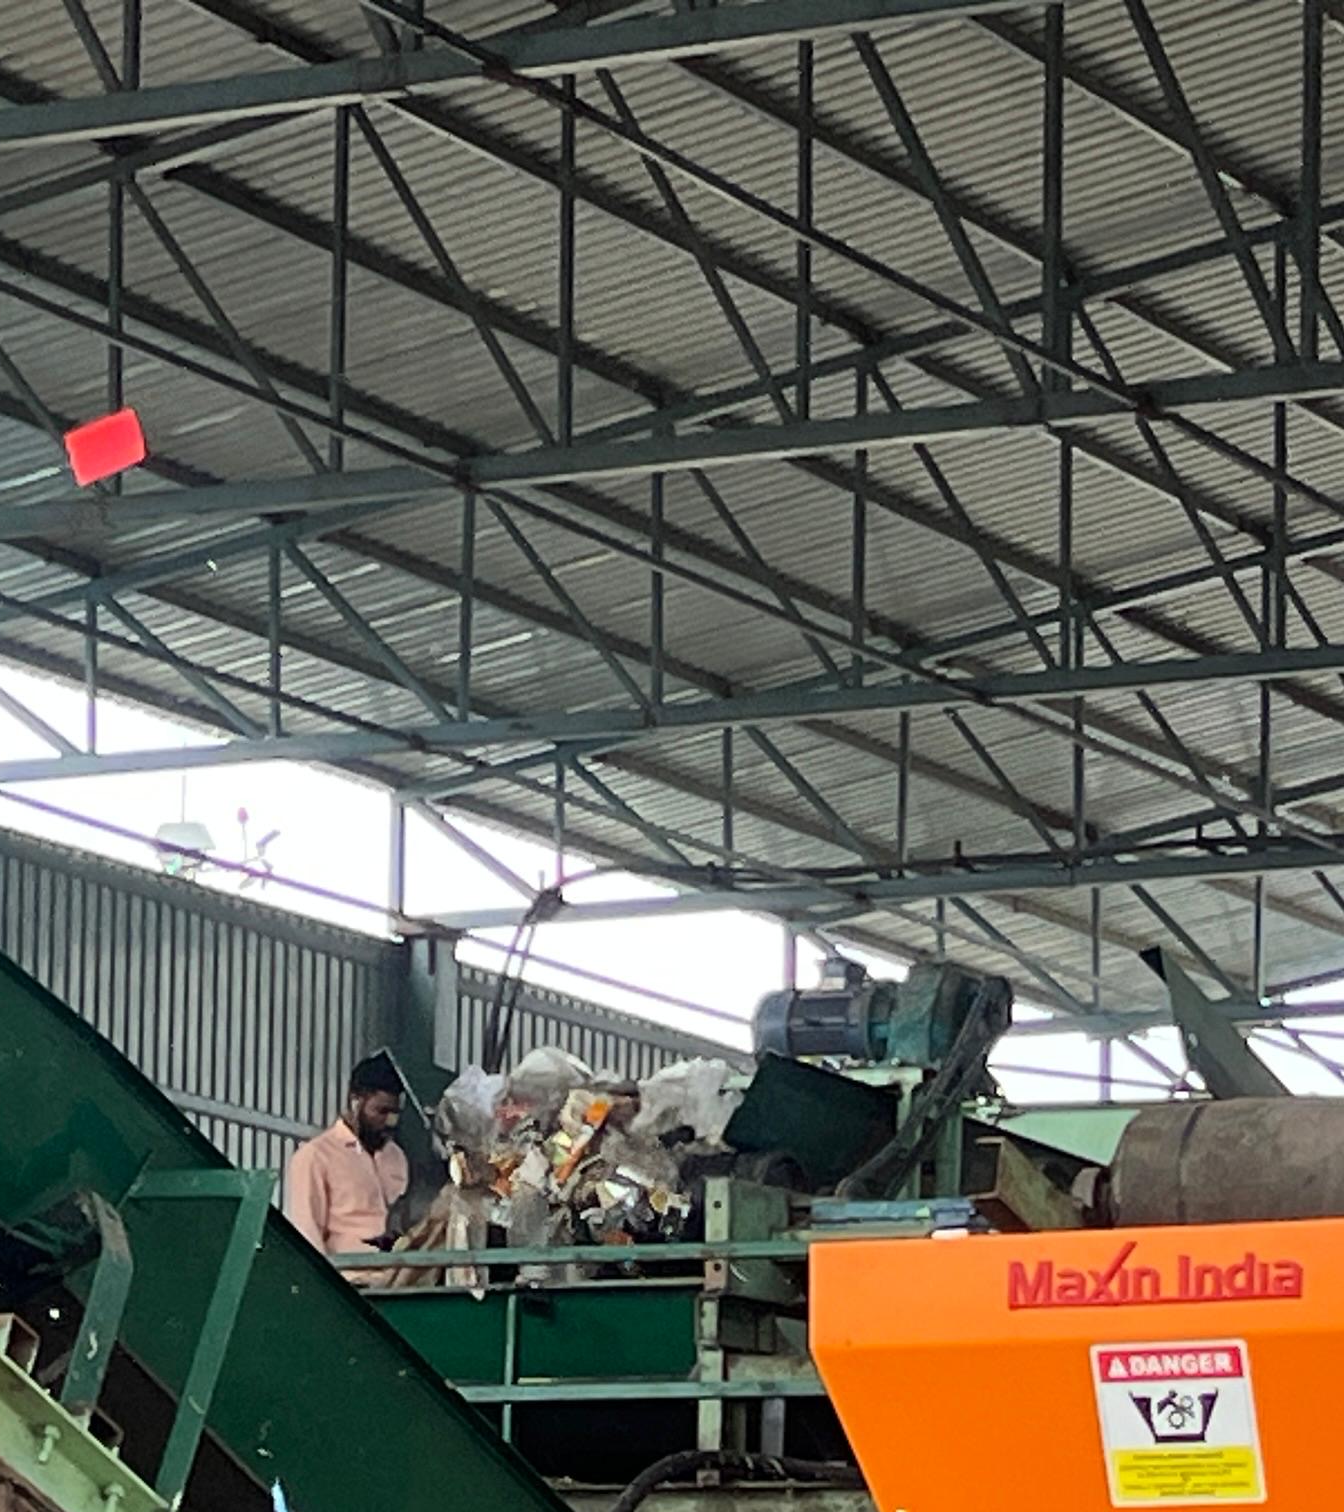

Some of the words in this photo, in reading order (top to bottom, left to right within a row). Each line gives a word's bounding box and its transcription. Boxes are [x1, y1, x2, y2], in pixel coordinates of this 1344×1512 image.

[1007, 1241, 1161, 1308] Maxin
[1178, 1252, 1304, 1300] India
[1129, 1352, 1233, 1377] DANGER
